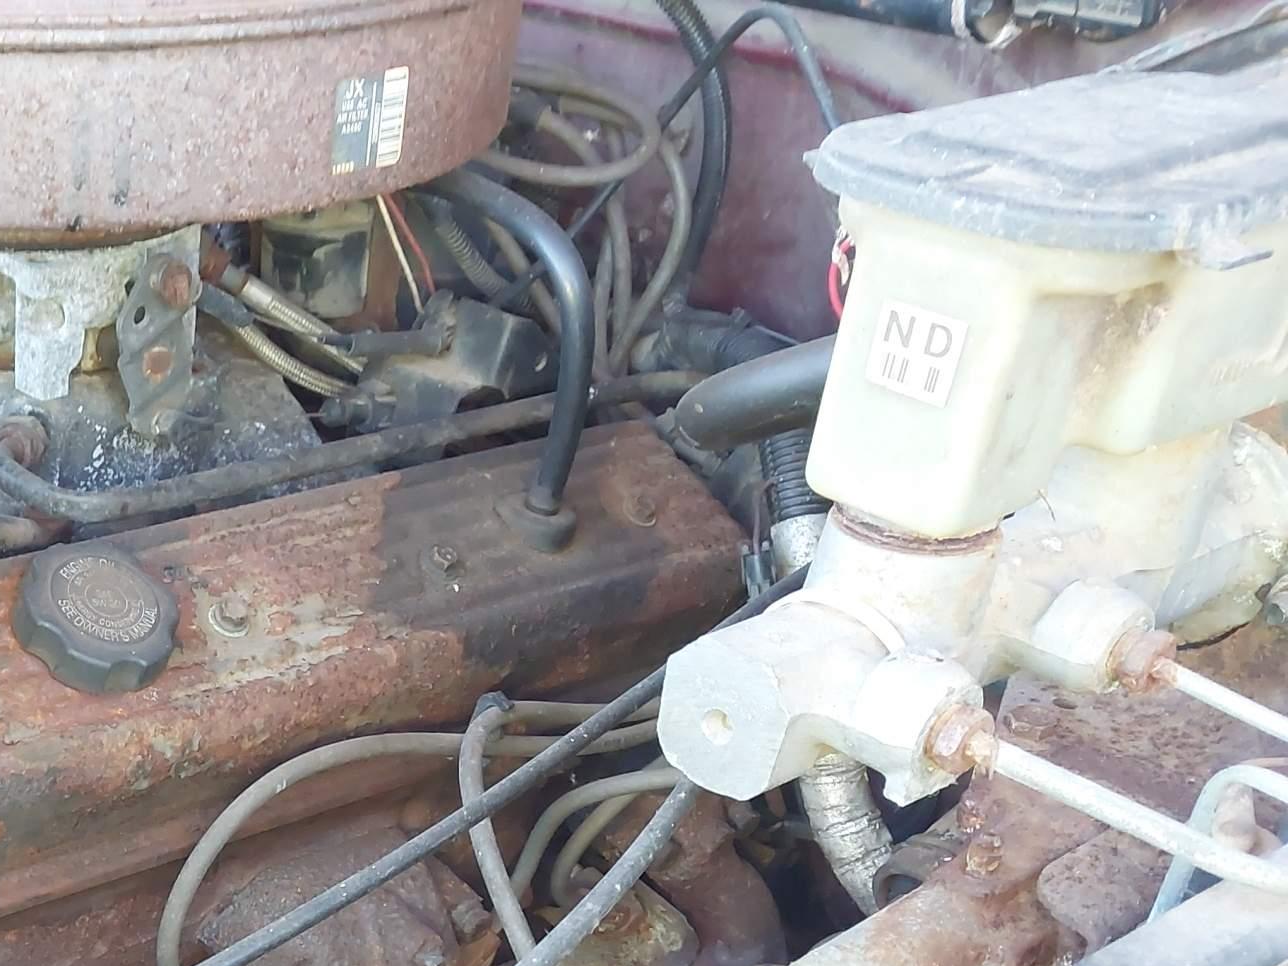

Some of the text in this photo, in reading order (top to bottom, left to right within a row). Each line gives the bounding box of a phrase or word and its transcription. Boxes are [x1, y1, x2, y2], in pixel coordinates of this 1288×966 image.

[344, 78, 365, 98] JX
[58, 599, 76, 620] SEE
[73, 616, 130, 642] OWNER'S
[128, 606, 158, 640] MANUAL
